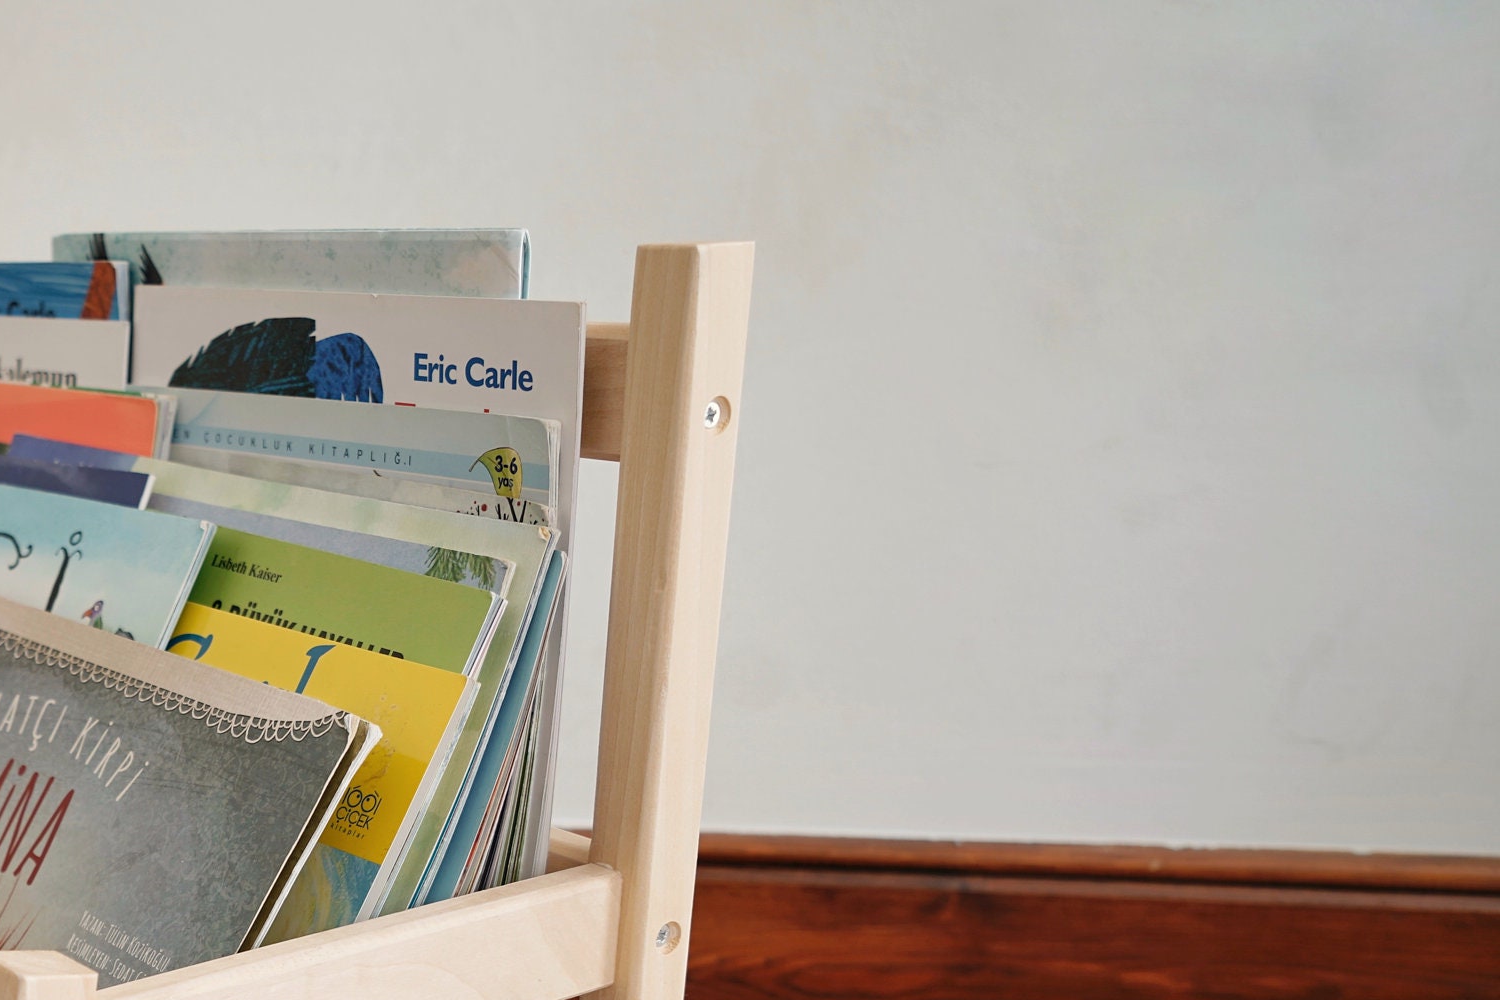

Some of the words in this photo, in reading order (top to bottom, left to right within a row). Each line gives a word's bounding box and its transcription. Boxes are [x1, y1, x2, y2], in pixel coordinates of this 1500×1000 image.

[413, 352, 457, 384] Eric
[465, 356, 533, 391] Carle
[203, 431, 293, 452] ÇOCUKLUK
[494, 454, 518, 475] 3-6
[497, 475, 514, 492] yaş
[211, 554, 247, 575] Lisbeth
[248, 564, 283, 584] Kaiser
[69, 716, 150, 802] KİRPİ
[336, 806, 374, 831] ÇİÇEK
[330, 822, 365, 840] kitaplar
